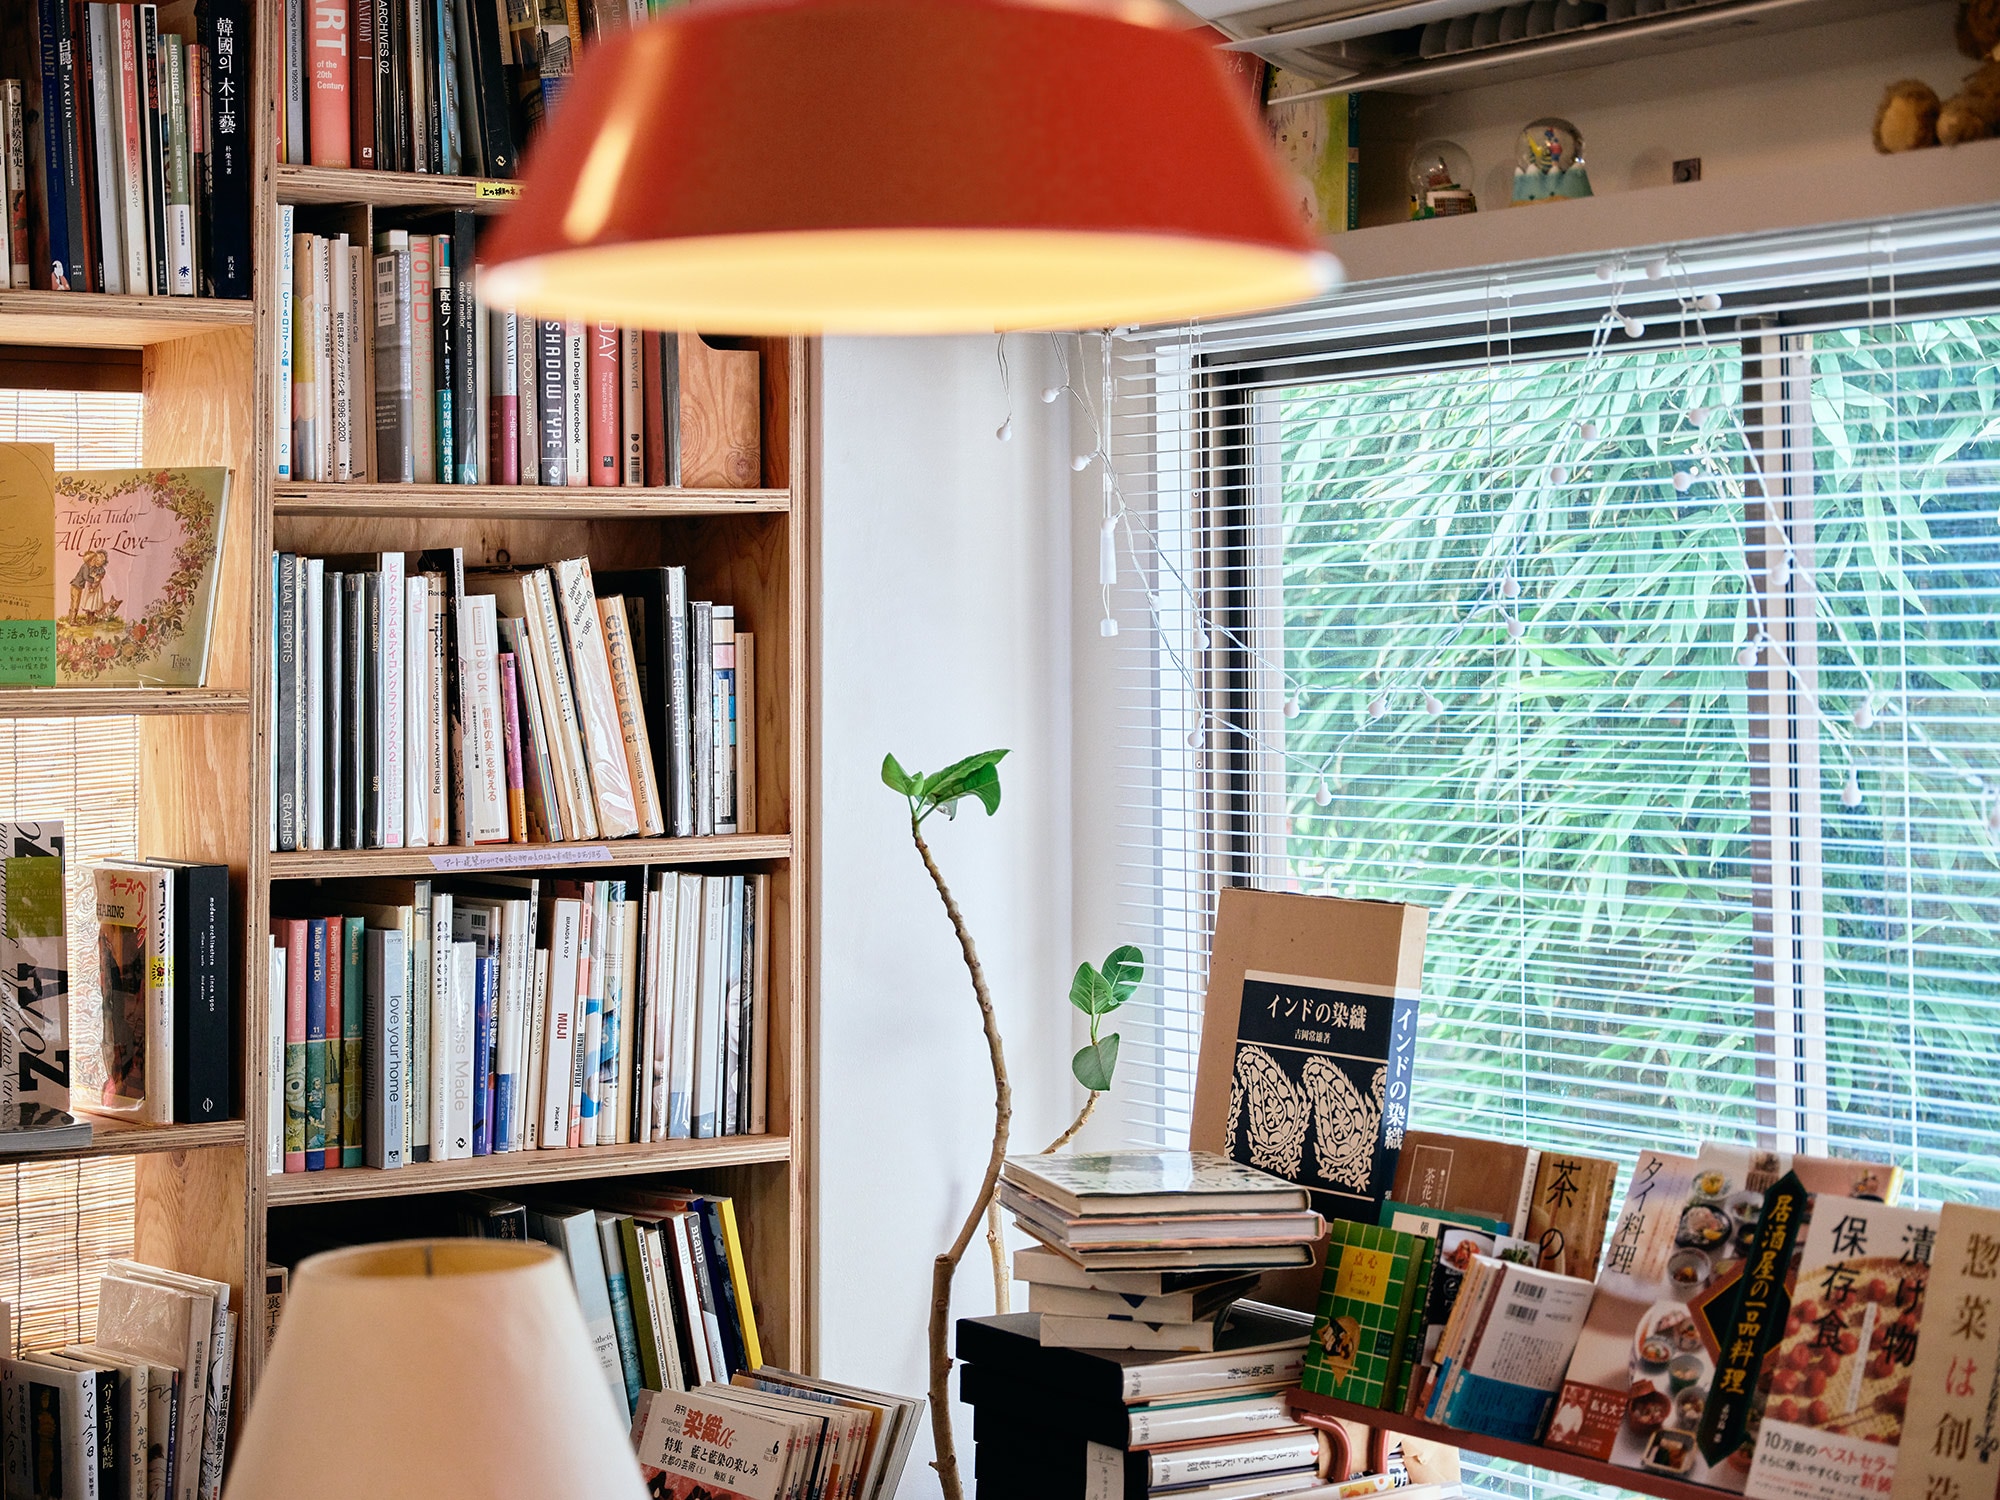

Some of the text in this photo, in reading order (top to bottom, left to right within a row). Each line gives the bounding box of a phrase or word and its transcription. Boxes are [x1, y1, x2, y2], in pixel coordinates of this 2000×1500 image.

[122, 18, 133, 71] 肉筆浮世絵
[315, 0, 347, 57] RT
[379, 0, 390, 75] ARCHIVES 02
[289, 0, 299, 102] Carnegie International 1999/2000
[316, 60, 338, 69] of the
[170, 44, 180, 104] HIROSHIGE'S
[216, 17, 237, 135] 韓國의 木工藝
[316, 70, 333, 79] 20th
[316, 81, 345, 92] Century
[63, 74, 72, 118] HAKUIN
[10, 108, 22, 168] 浮世絵の歴史
[351, 274, 359, 299] Designs:
[413, 241, 431, 324] WORD
[439, 288, 451, 355] 配色ノート
[466, 295, 474, 320] sixties
[522, 353, 533, 386] BOOK
[573, 337, 581, 359] Total
[336, 312, 347, 443] 現代日本のブックデザイン史 1996-2020
[466, 367, 474, 394] london
[545, 321, 562, 448] SHADOW TYPE
[572, 361, 581, 391] Design
[280, 443, 288, 454] 2
[57, 504, 150, 525] Tasha Tudor
[55, 525, 156, 557] All for Love
[572, 590, 594, 627] Werbung
[581, 616, 594, 637] 1981
[371, 625, 379, 653] publicity
[429, 612, 447, 660] Impact
[475, 650, 488, 693] BOOK
[672, 620, 685, 747] ART CREATIVITY
[282, 557, 293, 845] ANNUAL REPORTS GRAPHIS
[482, 707, 498, 802] 情報の美 を考える
[372, 775, 380, 792] 1978
[96, 903, 125, 919] HARING
[208, 897, 216, 923] modern
[329, 925, 338, 1008] Poems and Rhymes
[351, 925, 359, 966] About Me
[294, 927, 304, 1021] Holidays and Customs
[313, 968, 321, 982] Do
[312, 1025, 321, 1034] 11
[556, 1012, 568, 1040] MUJI
[1266, 993, 1368, 1032] インドの染織
[387, 995, 402, 1102] love your home
[1293, 1028, 1332, 1045] 吉岡常雄著
[19, 1049, 70, 1092] Z
[454, 1061, 470, 1112] Made
[1383, 1007, 1413, 1151] インドの染織
[1539, 1158, 1583, 1261] 茶の
[1607, 1156, 1664, 1276] タイ料理
[1352, 1251, 1379, 1270] 点心
[1719, 1193, 1795, 1397] 居酒屋の一品料理
[1805, 1214, 1872, 1356] 保存食
[1880, 1223, 1938, 1369] 漬け物
[131, 1372, 148, 1466] うつろうかたち
[673, 1404, 736, 1449] 月刊 染織α
[664, 1437, 760, 1477] 特集 藍と藍染の楽しみ
[772, 1440, 780, 1455] 6
